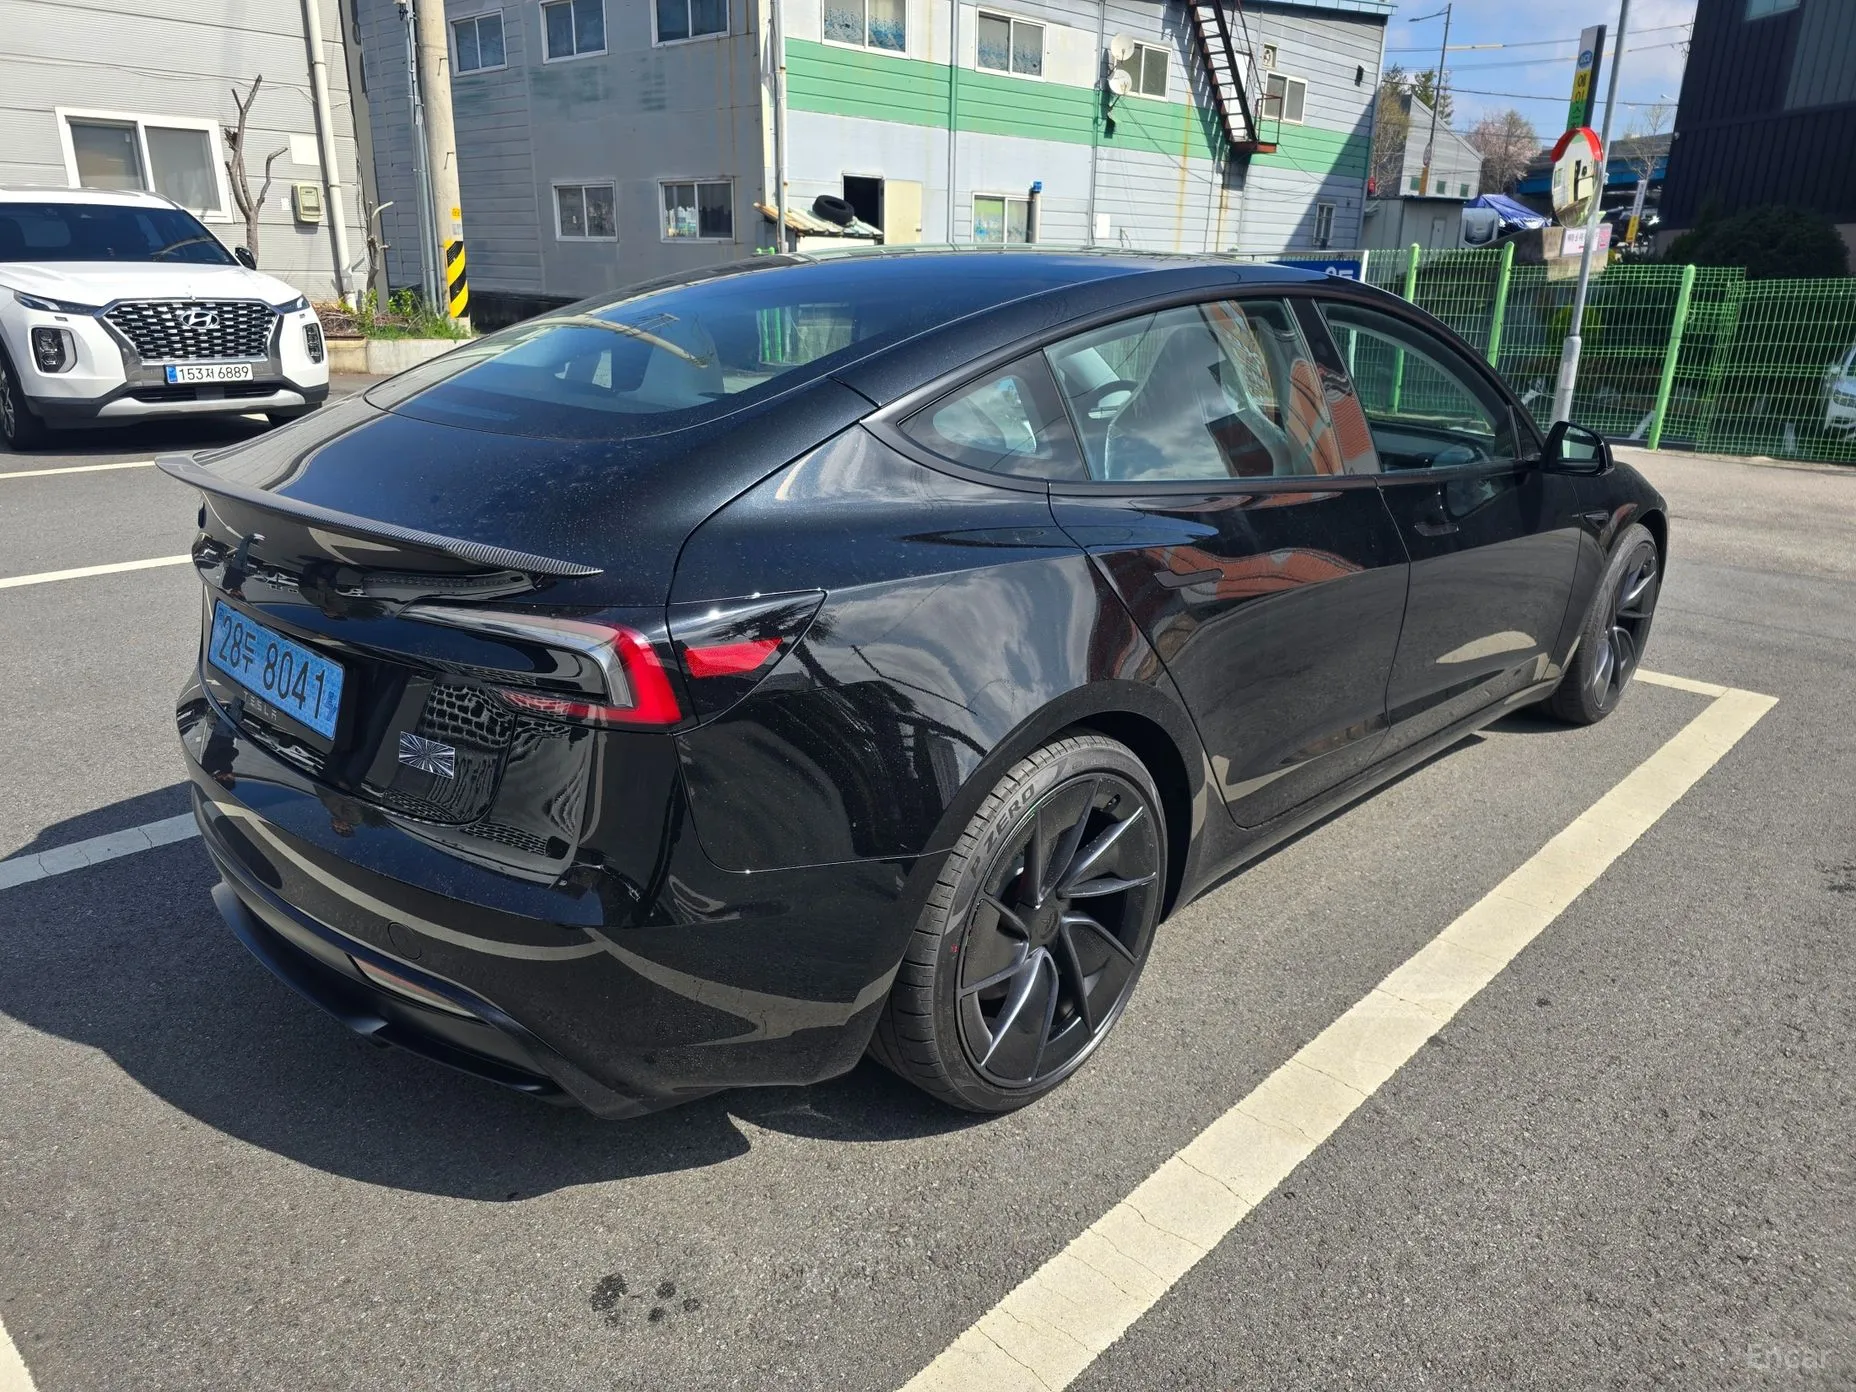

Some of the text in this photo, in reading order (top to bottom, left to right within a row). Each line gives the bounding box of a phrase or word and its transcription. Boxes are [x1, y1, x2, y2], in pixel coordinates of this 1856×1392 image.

[179, 365, 249, 381] 153저 6889
[218, 615, 257, 674] 28두
[263, 640, 326, 720] 8041
[243, 690, 277, 721] TESLA
[970, 783, 1035, 880] P ZERO
